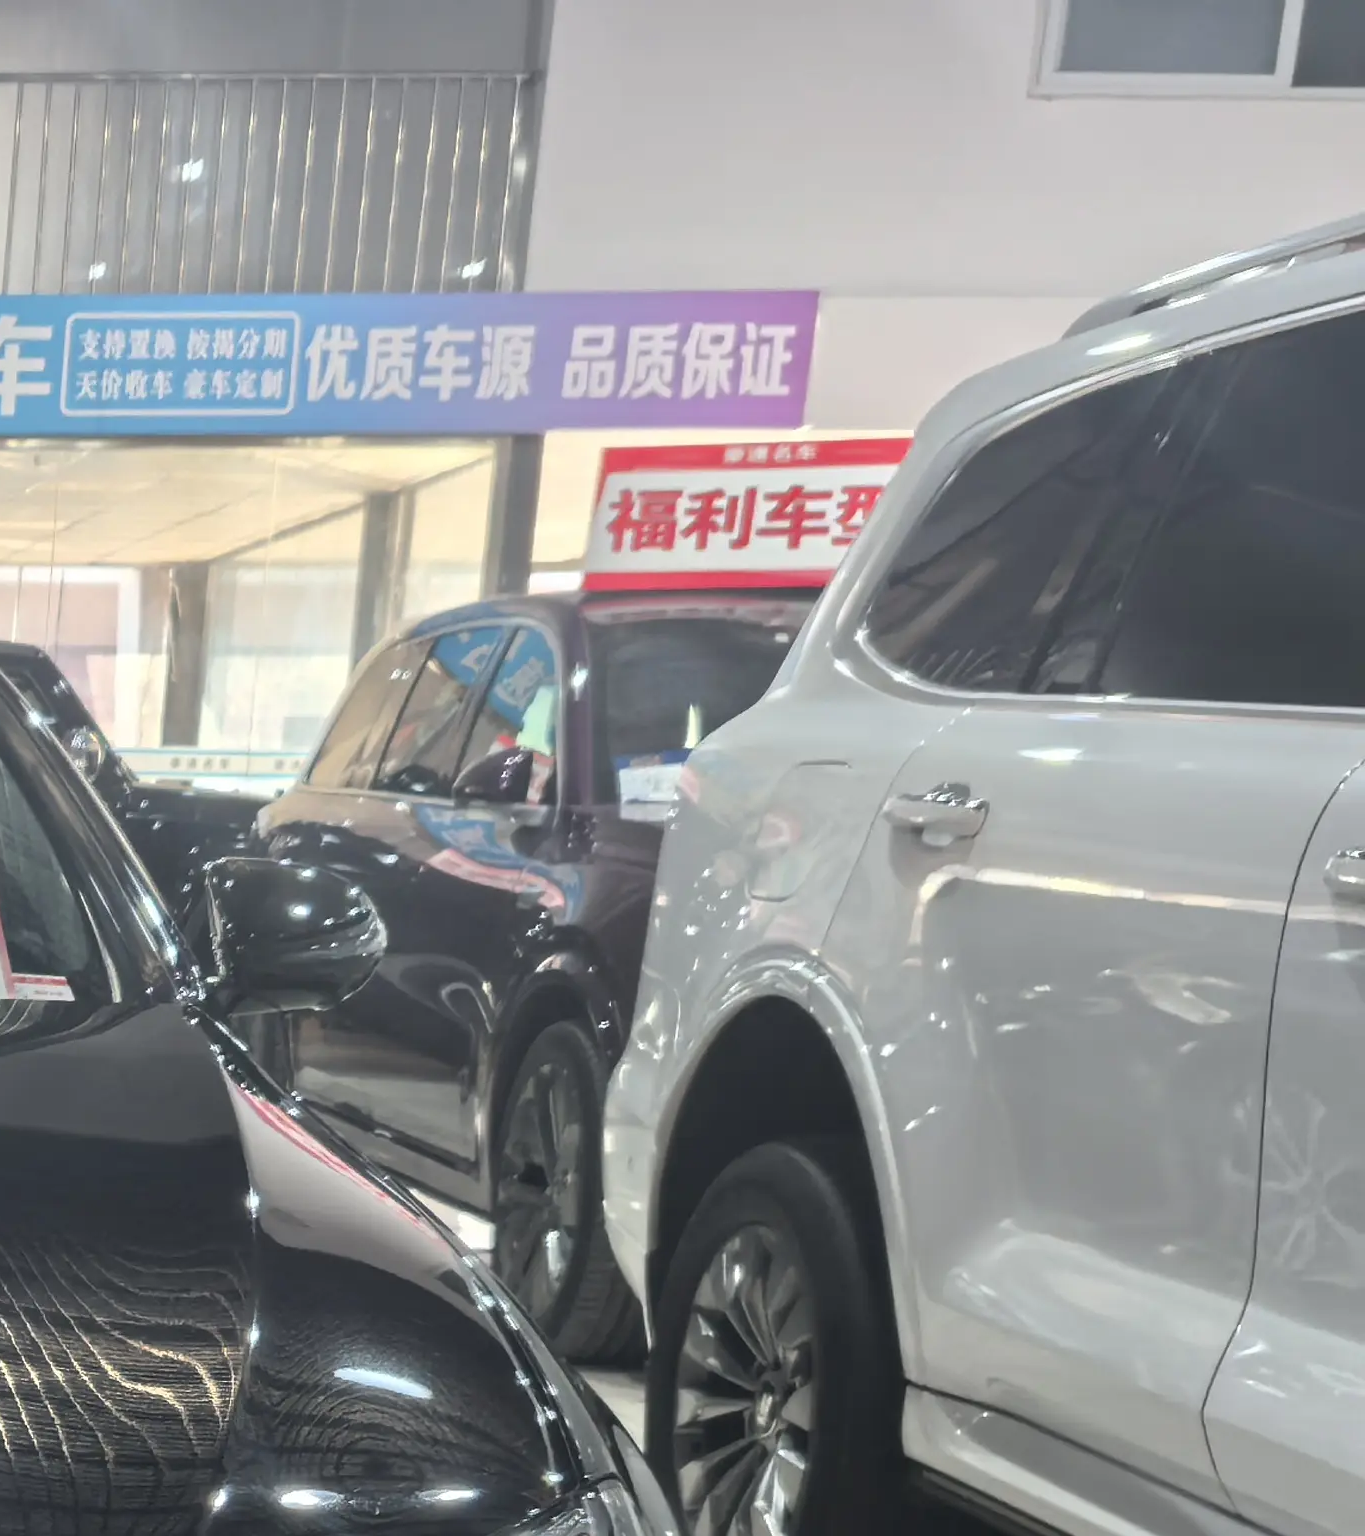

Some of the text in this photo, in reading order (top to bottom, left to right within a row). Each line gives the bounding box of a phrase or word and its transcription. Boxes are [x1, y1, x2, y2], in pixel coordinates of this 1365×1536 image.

[77, 327, 289, 361] 支持置换 按揭分期
[303, 322, 799, 402] 优质车源 品质保证
[605, 485, 886, 554] 福利车型
